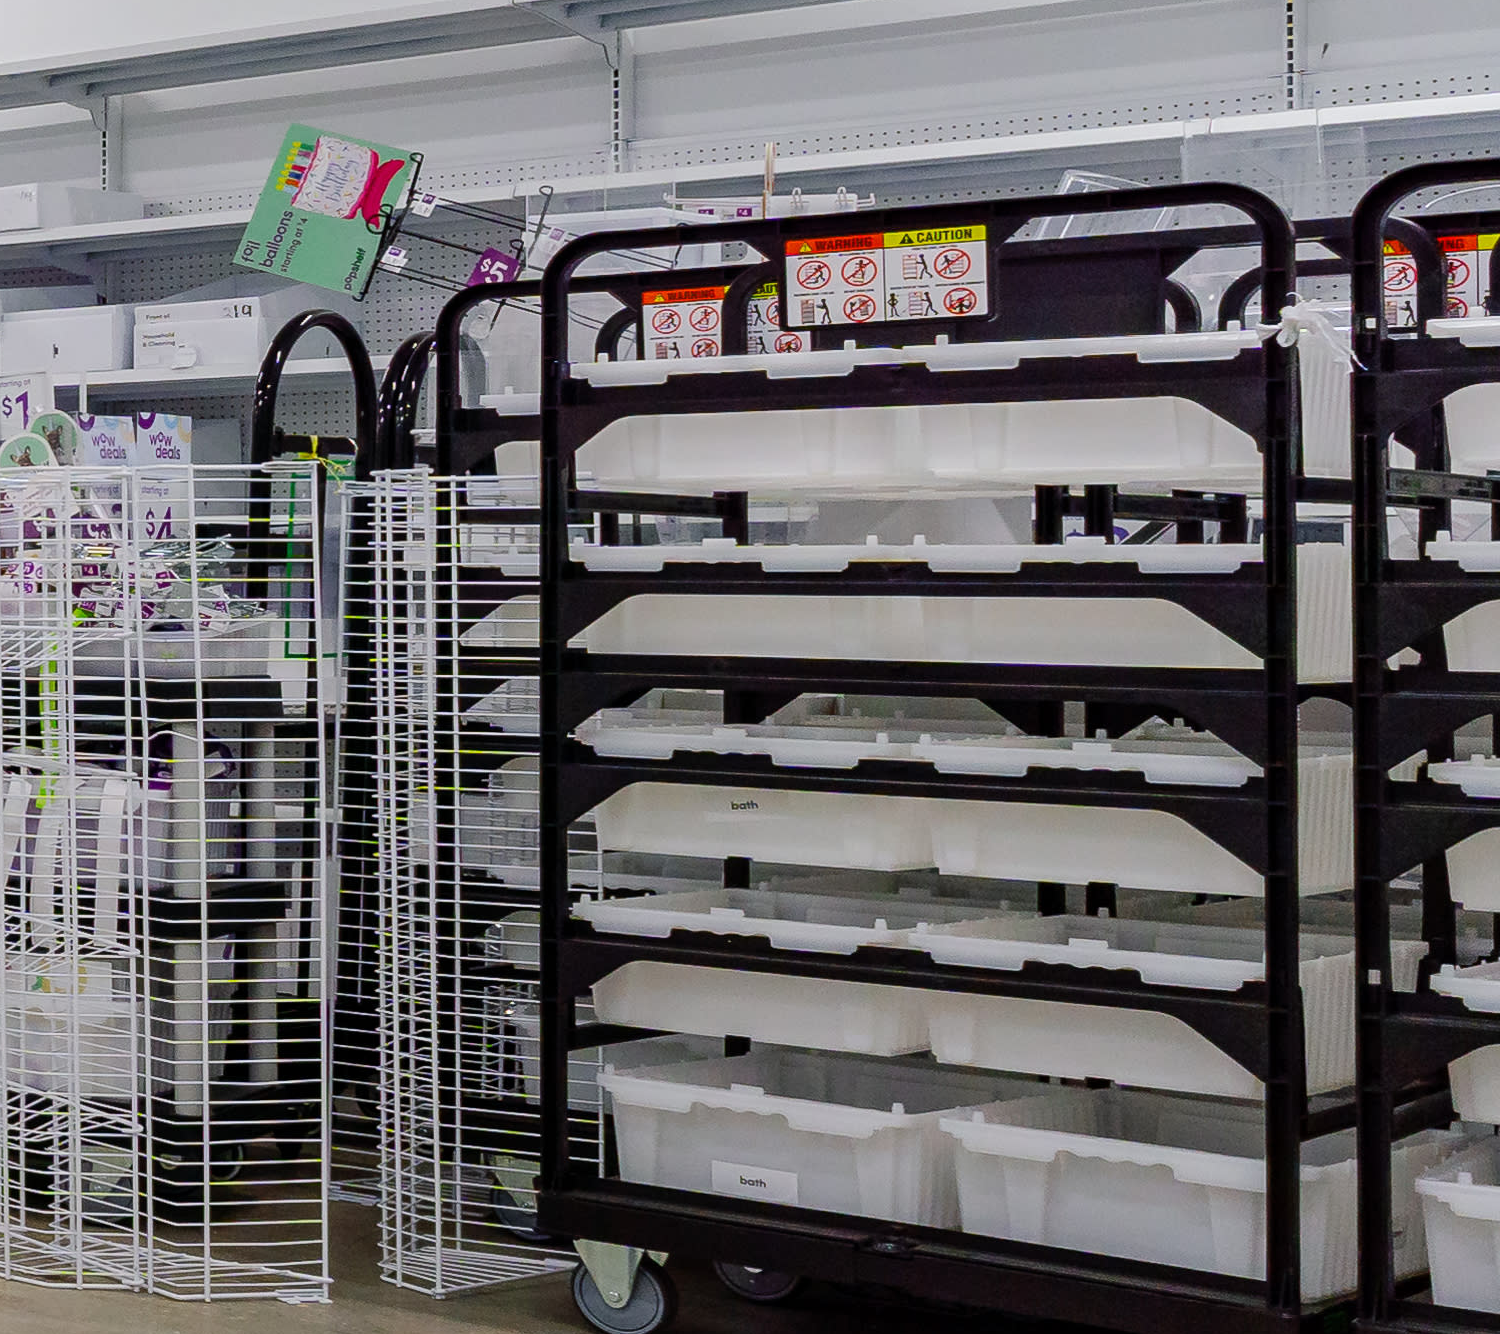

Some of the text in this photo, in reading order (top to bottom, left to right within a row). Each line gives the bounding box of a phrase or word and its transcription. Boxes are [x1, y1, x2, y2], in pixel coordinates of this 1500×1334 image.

[260, 210, 294, 268] balloons
[916, 228, 973, 244] CAUTION
[240, 239, 262, 263] foil
[815, 237, 873, 251] WARNING
[280, 237, 303, 273] starting
[343, 247, 367, 292] popshelf
[480, 258, 509, 285] $5
[666, 288, 716, 302] WARNING
[141, 331, 175, 340] Household
[1, 390, 30, 431] $1
[91, 432, 116, 447] wow
[149, 431, 173, 447] wow
[99, 445, 127, 460] deals
[155, 445, 181, 460] deals
[730, 799, 760, 811] bath
[739, 1175, 767, 1188] bath
